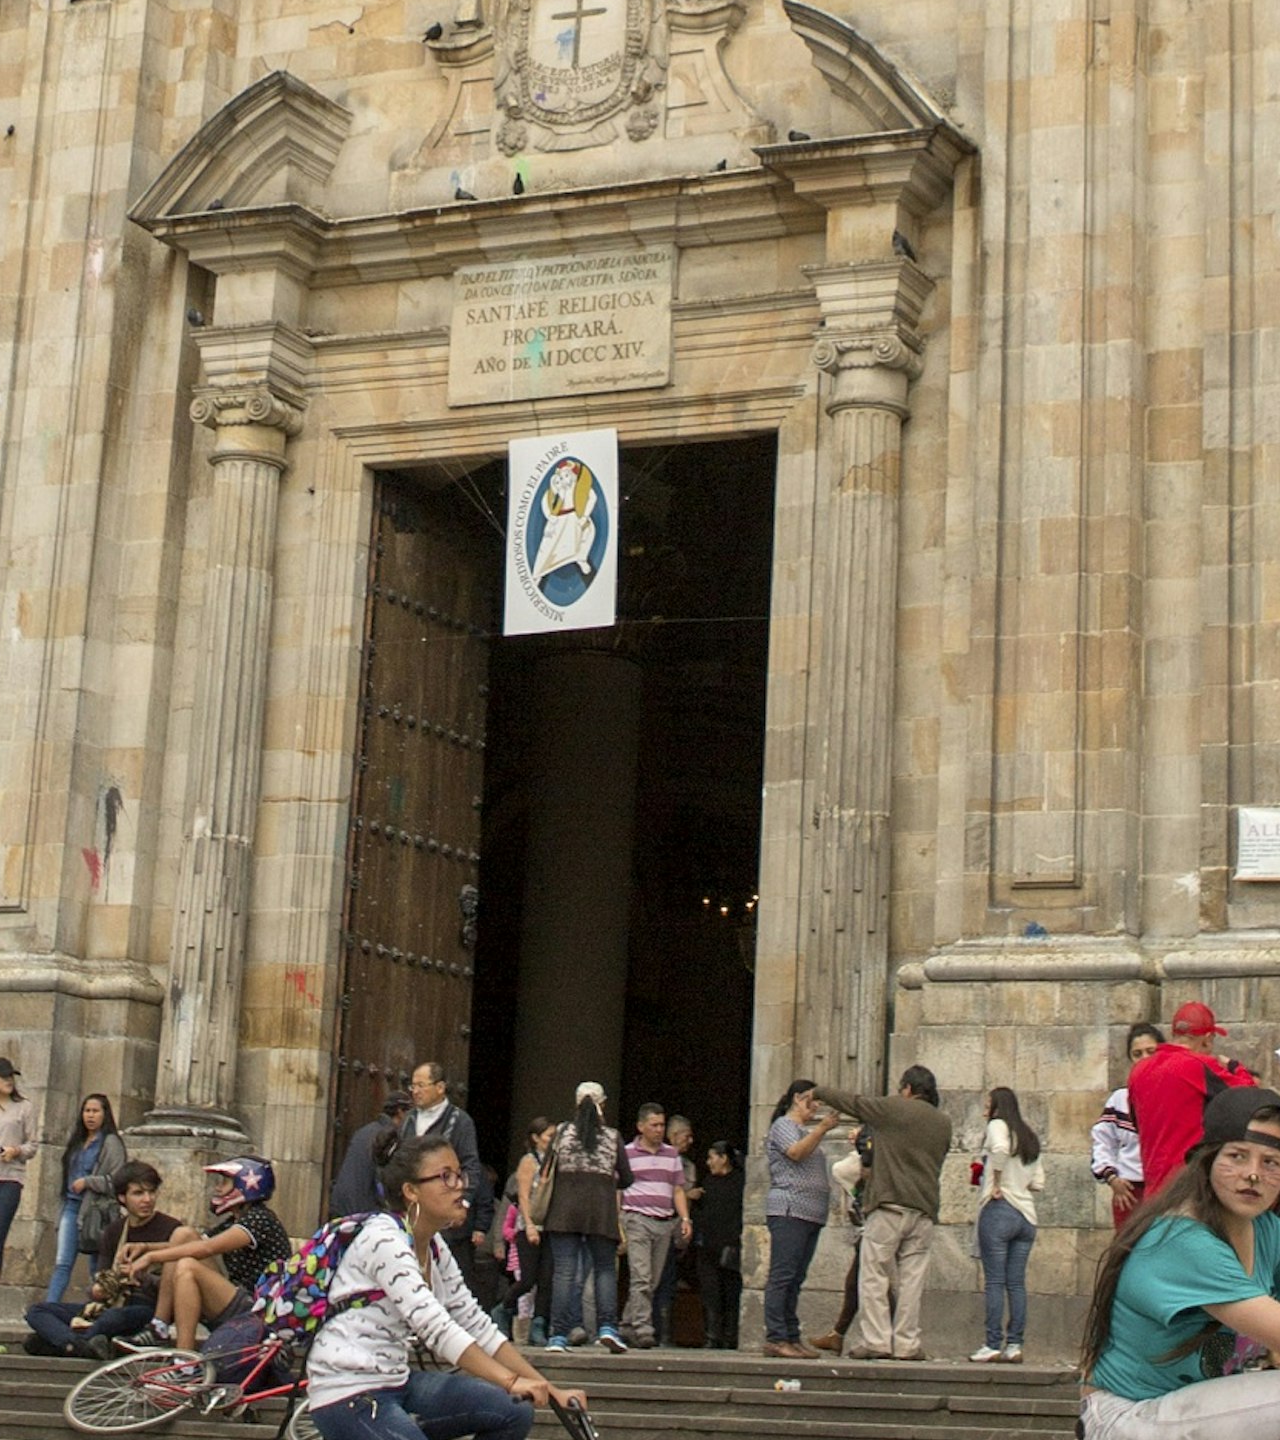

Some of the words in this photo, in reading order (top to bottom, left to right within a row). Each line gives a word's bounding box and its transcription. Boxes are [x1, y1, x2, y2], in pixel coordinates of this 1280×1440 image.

[566, 272, 615, 289] NUESTRA
[619, 267, 657, 282] SEÑORA
[465, 296, 549, 326] SANTAFÉ
[558, 290, 655, 316] RELIGIOSA
[502, 313, 623, 346] PROSPERARÁ.
[473, 355, 506, 375] AÑO
[512, 357, 532, 370] DE
[537, 440, 569, 473] PADRE
[527, 473, 540, 490] EL
[516, 490, 532, 528] COMO
[512, 529, 565, 623] MISERICORDIOSOS
